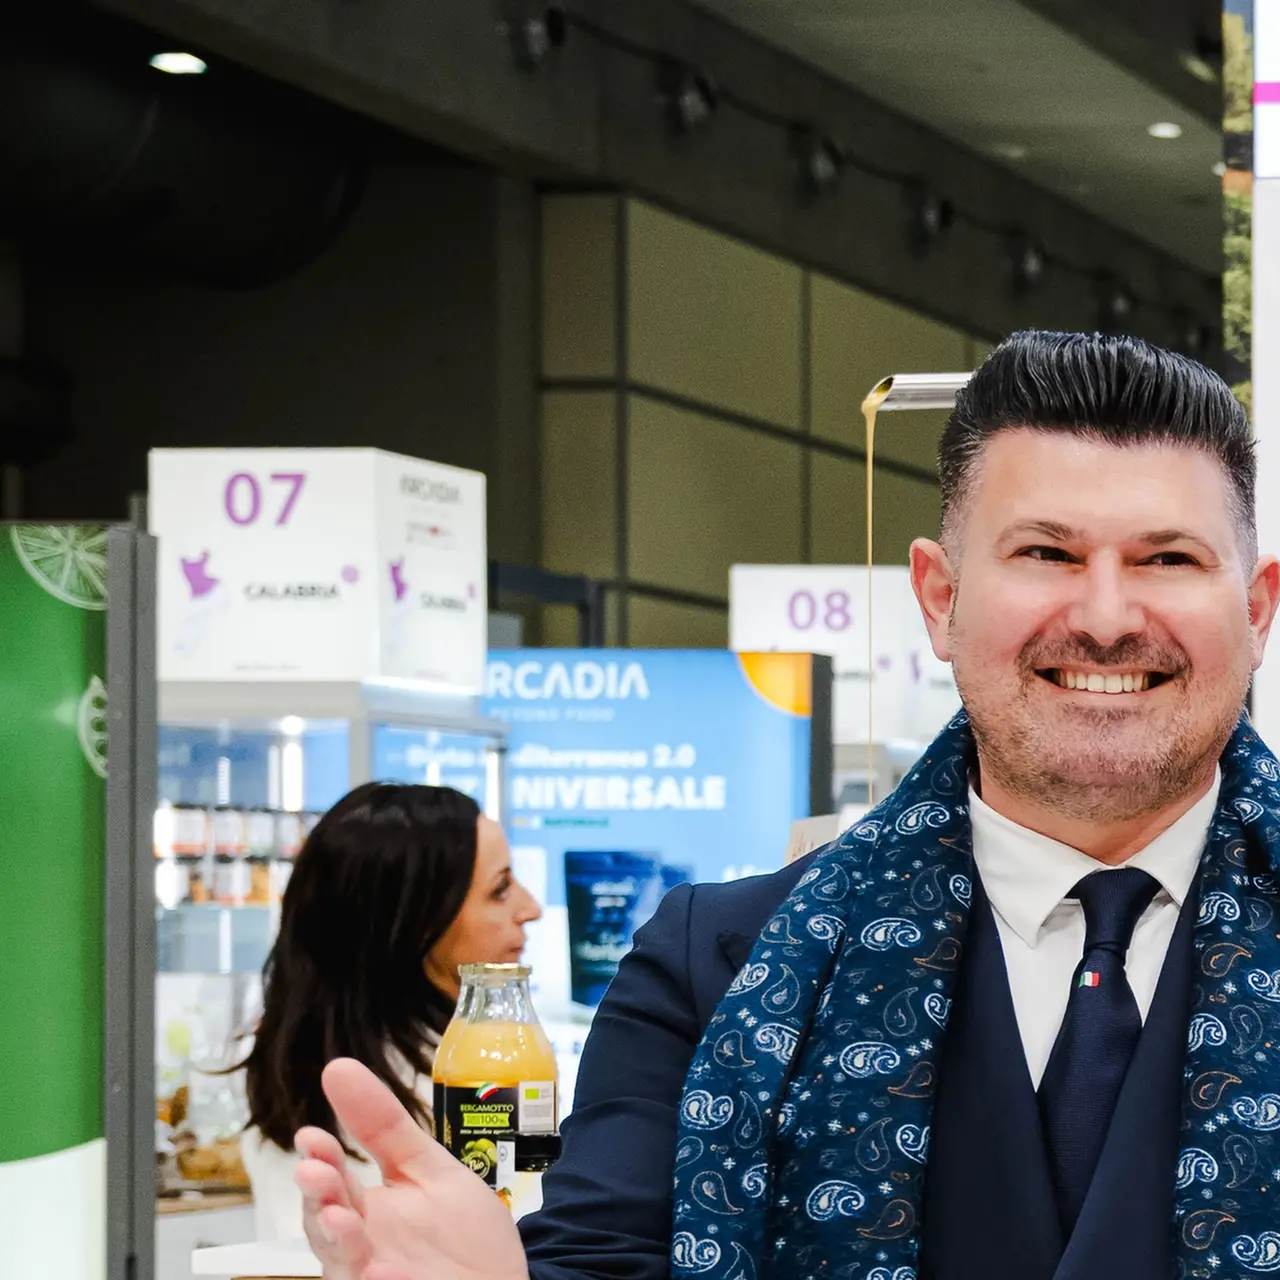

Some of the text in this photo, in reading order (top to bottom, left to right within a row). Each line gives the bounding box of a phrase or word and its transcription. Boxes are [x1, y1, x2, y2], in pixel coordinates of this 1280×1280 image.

[224, 473, 307, 527] 07
[243, 583, 340, 600] CALABRIA
[788, 590, 852, 631] 08
[487, 661, 650, 699] RCADIA
[652, 743, 697, 769] 2.0
[512, 776, 726, 810] NIVERSALE
[460, 1104, 514, 1113] BERGAMOTTO
